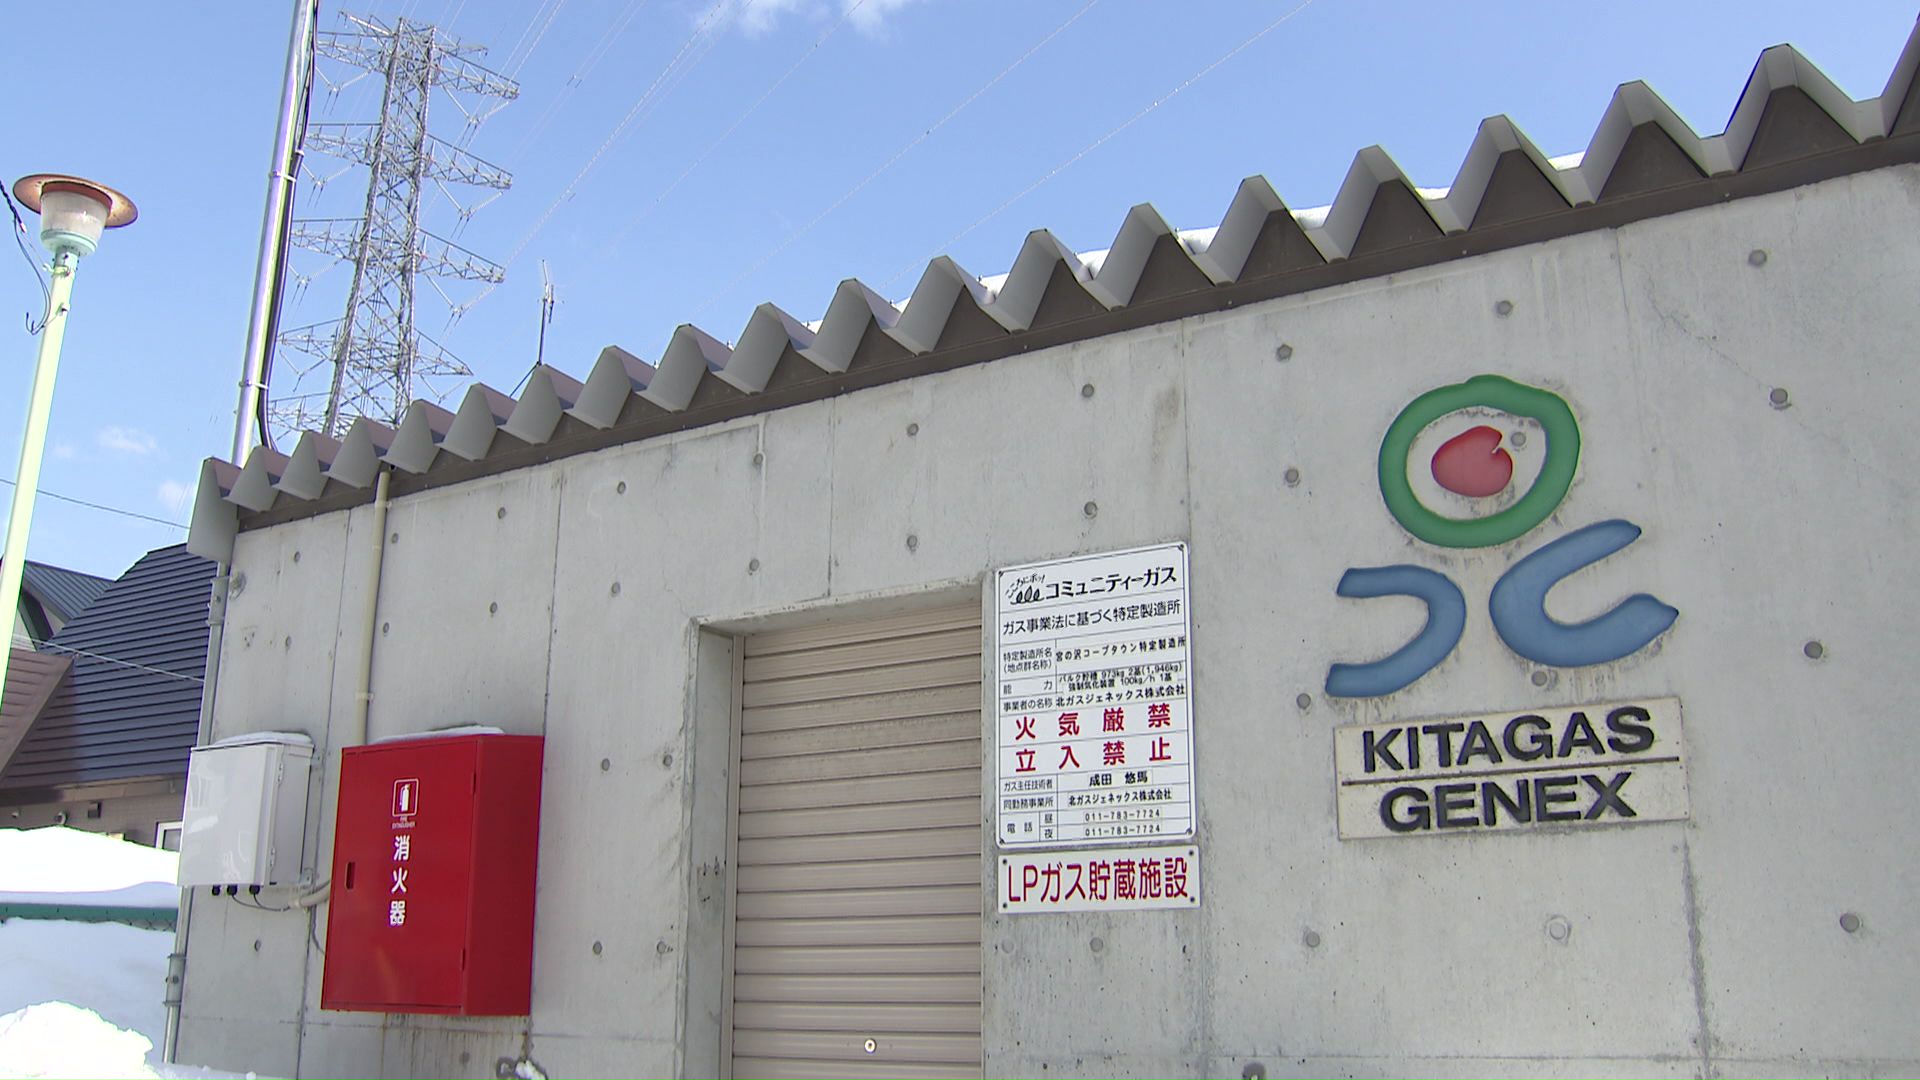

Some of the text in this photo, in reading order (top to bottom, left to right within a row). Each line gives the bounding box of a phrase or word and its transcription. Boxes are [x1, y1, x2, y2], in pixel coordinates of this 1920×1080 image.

[1045, 566, 1177, 600] コミュニティーガス
[1003, 599, 1181, 636] ガス事業法に基づく特定製造所
[1003, 647, 1052, 662] 特定製造所名
[1003, 697, 1053, 712] 事業者の名称
[1056, 684, 1185, 707] 北ガスジェネックス株式会社
[1015, 703, 1171, 741] 火気厳禁
[1015, 736, 1172, 772] 立入禁止
[1362, 706, 1655, 774] KITAGAS
[1004, 779, 1053, 792] ガス主任技術者
[1069, 787, 1172, 807] 北ガスジェネックス株式会社
[1003, 796, 1053, 810] 同勤務事業所
[1085, 809, 1160, 822] 011-783-7724
[1379, 771, 1637, 833] GENEX
[1085, 824, 1160, 837] 011-783-7724
[389, 835, 411, 926] 消火器
[1008, 857, 1188, 903] LPガス貯蔵施設
